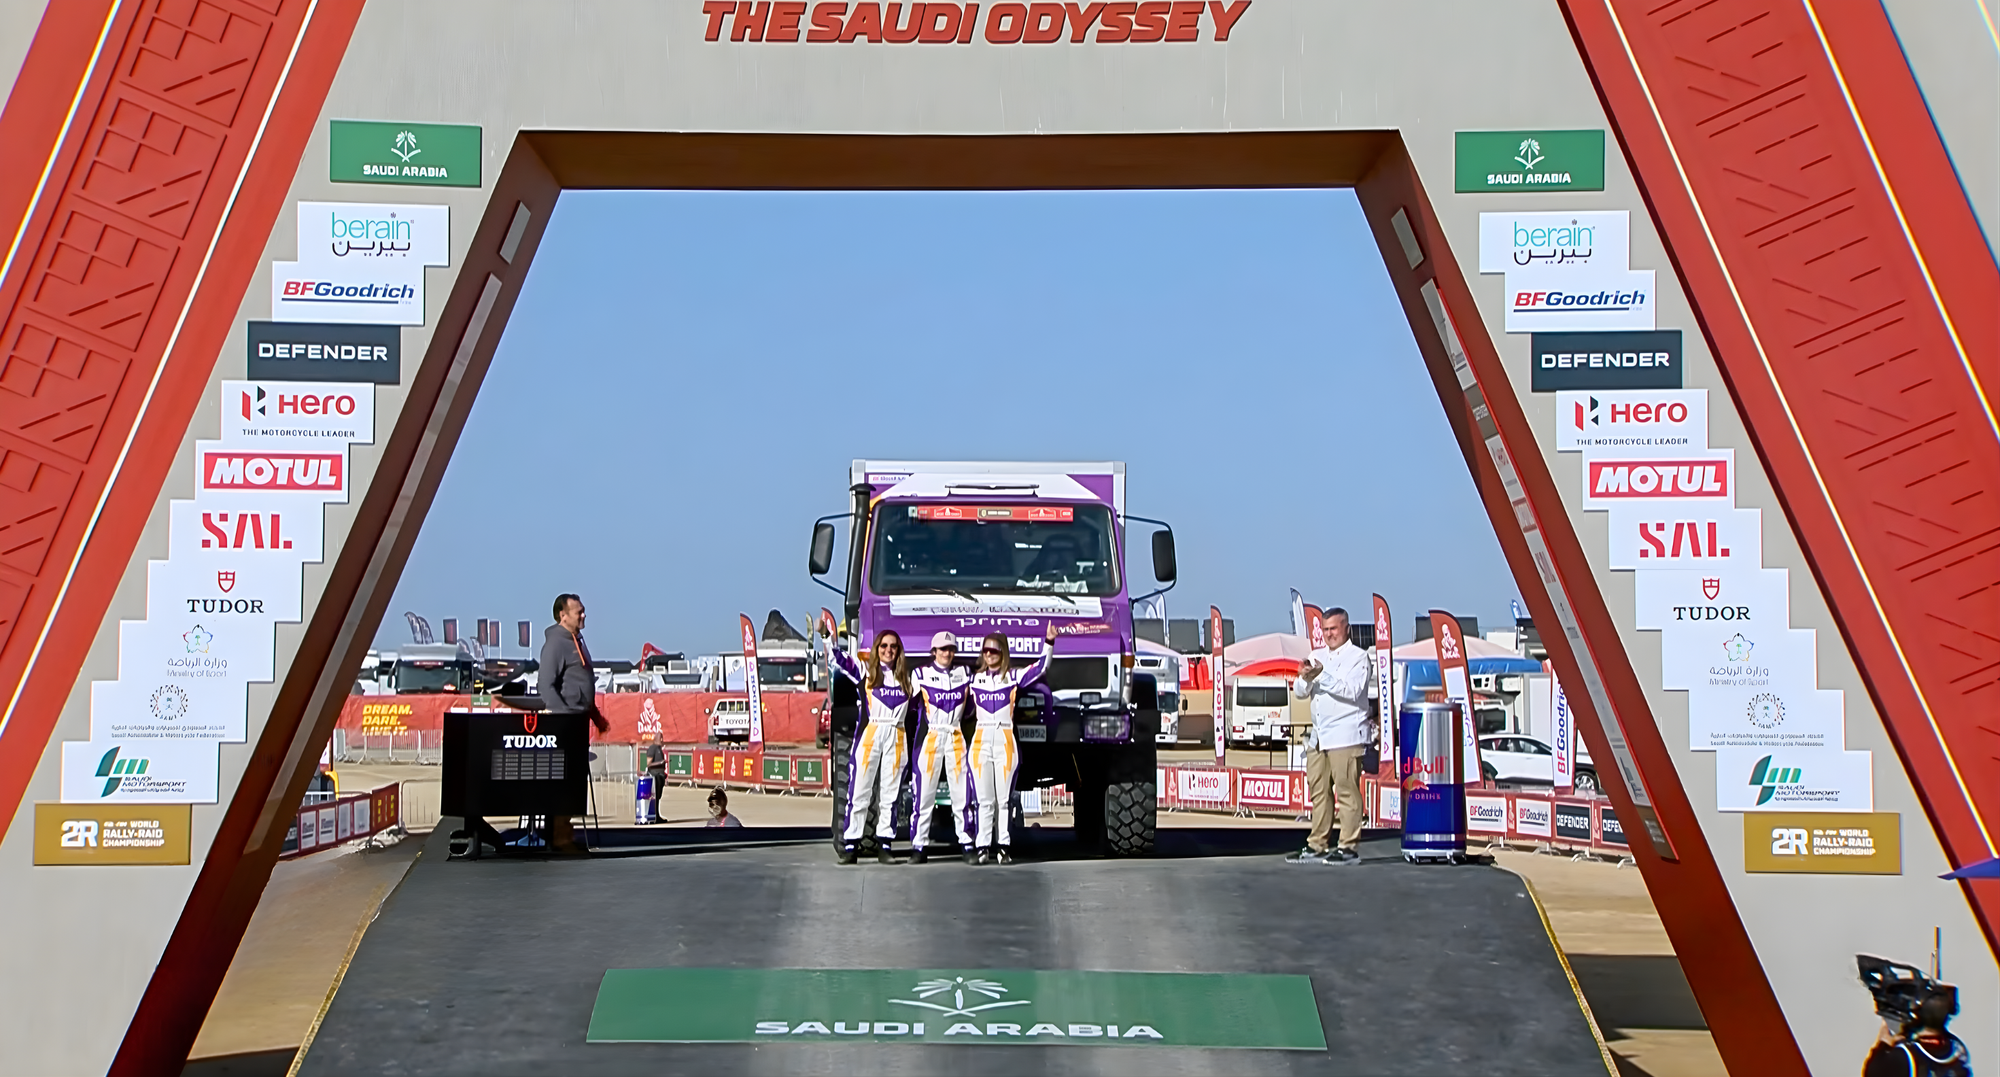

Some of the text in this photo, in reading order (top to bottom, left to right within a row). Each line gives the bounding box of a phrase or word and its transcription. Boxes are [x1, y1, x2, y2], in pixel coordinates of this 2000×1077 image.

[703, 0, 1251, 43] THE SAUDI ODYSSEY
[363, 164, 448, 178] SAUDI ARABIA
[1487, 172, 1571, 185] SAUDI ARABIA
[331, 211, 411, 240] berain
[1513, 219, 1593, 247] berain
[283, 281, 415, 299] BFGoodrich
[1514, 290, 1646, 307] BFGoodrich
[258, 343, 388, 361] DEFENDER
[1541, 352, 1670, 368] DEFENDER
[278, 394, 356, 416] Hero
[1610, 402, 1688, 423] Hero
[242, 428, 355, 438] THE MOTORCYCLE LEADER
[1576, 437, 1688, 446] THE MOTORCYCLE LEADER
[210, 457, 337, 486] MOTUL
[1595, 465, 1722, 493] MOTUL
[186, 599, 264, 614] TUDOR
[1673, 606, 1751, 621] TUDOR
[958, 637, 1041, 652] TEC PORT
[362, 704, 413, 715] DREAM.
[362, 716, 401, 726] DARE.
[1556, 681, 1566, 774] BFGoodric
[502, 734, 558, 748] TUDOR
[1412, 756, 1445, 774] Bull
[1197, 776, 1219, 789] Hero
[1244, 780, 1284, 798] MOTUL
[130, 821, 160, 829] WORLD
[1556, 814, 1589, 830] DEFENDER
[1839, 829, 1869, 837] WORLD
[103, 839, 165, 847] CHAMPIONSHIP
[1813, 847, 1876, 855] CHAMPIONSHIP
[755, 1020, 1164, 1038] SAUDI ARABIA
